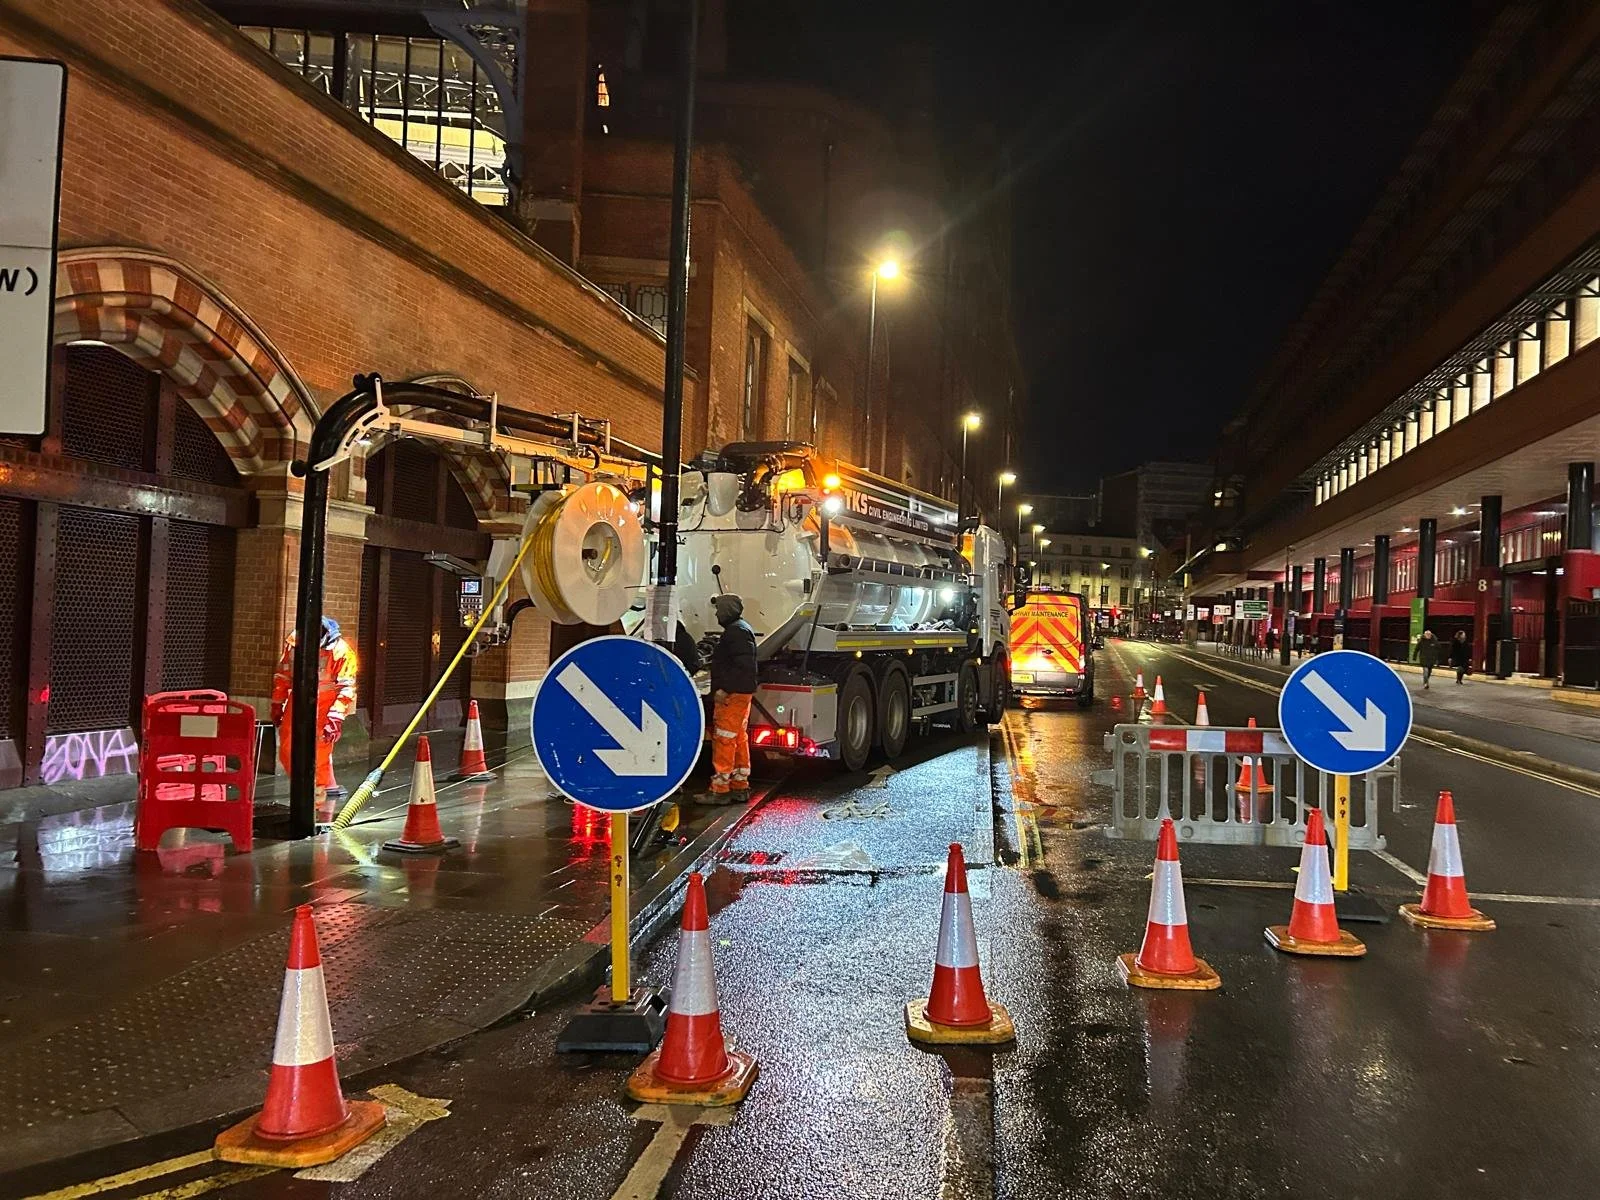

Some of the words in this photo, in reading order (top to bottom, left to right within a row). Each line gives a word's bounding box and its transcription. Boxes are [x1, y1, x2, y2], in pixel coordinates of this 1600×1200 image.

[844, 488, 868, 515] TKS
[868, 505, 882, 519] CIVIL
[913, 518, 928, 532] LIMITED
[1477, 578, 1488, 592] 8
